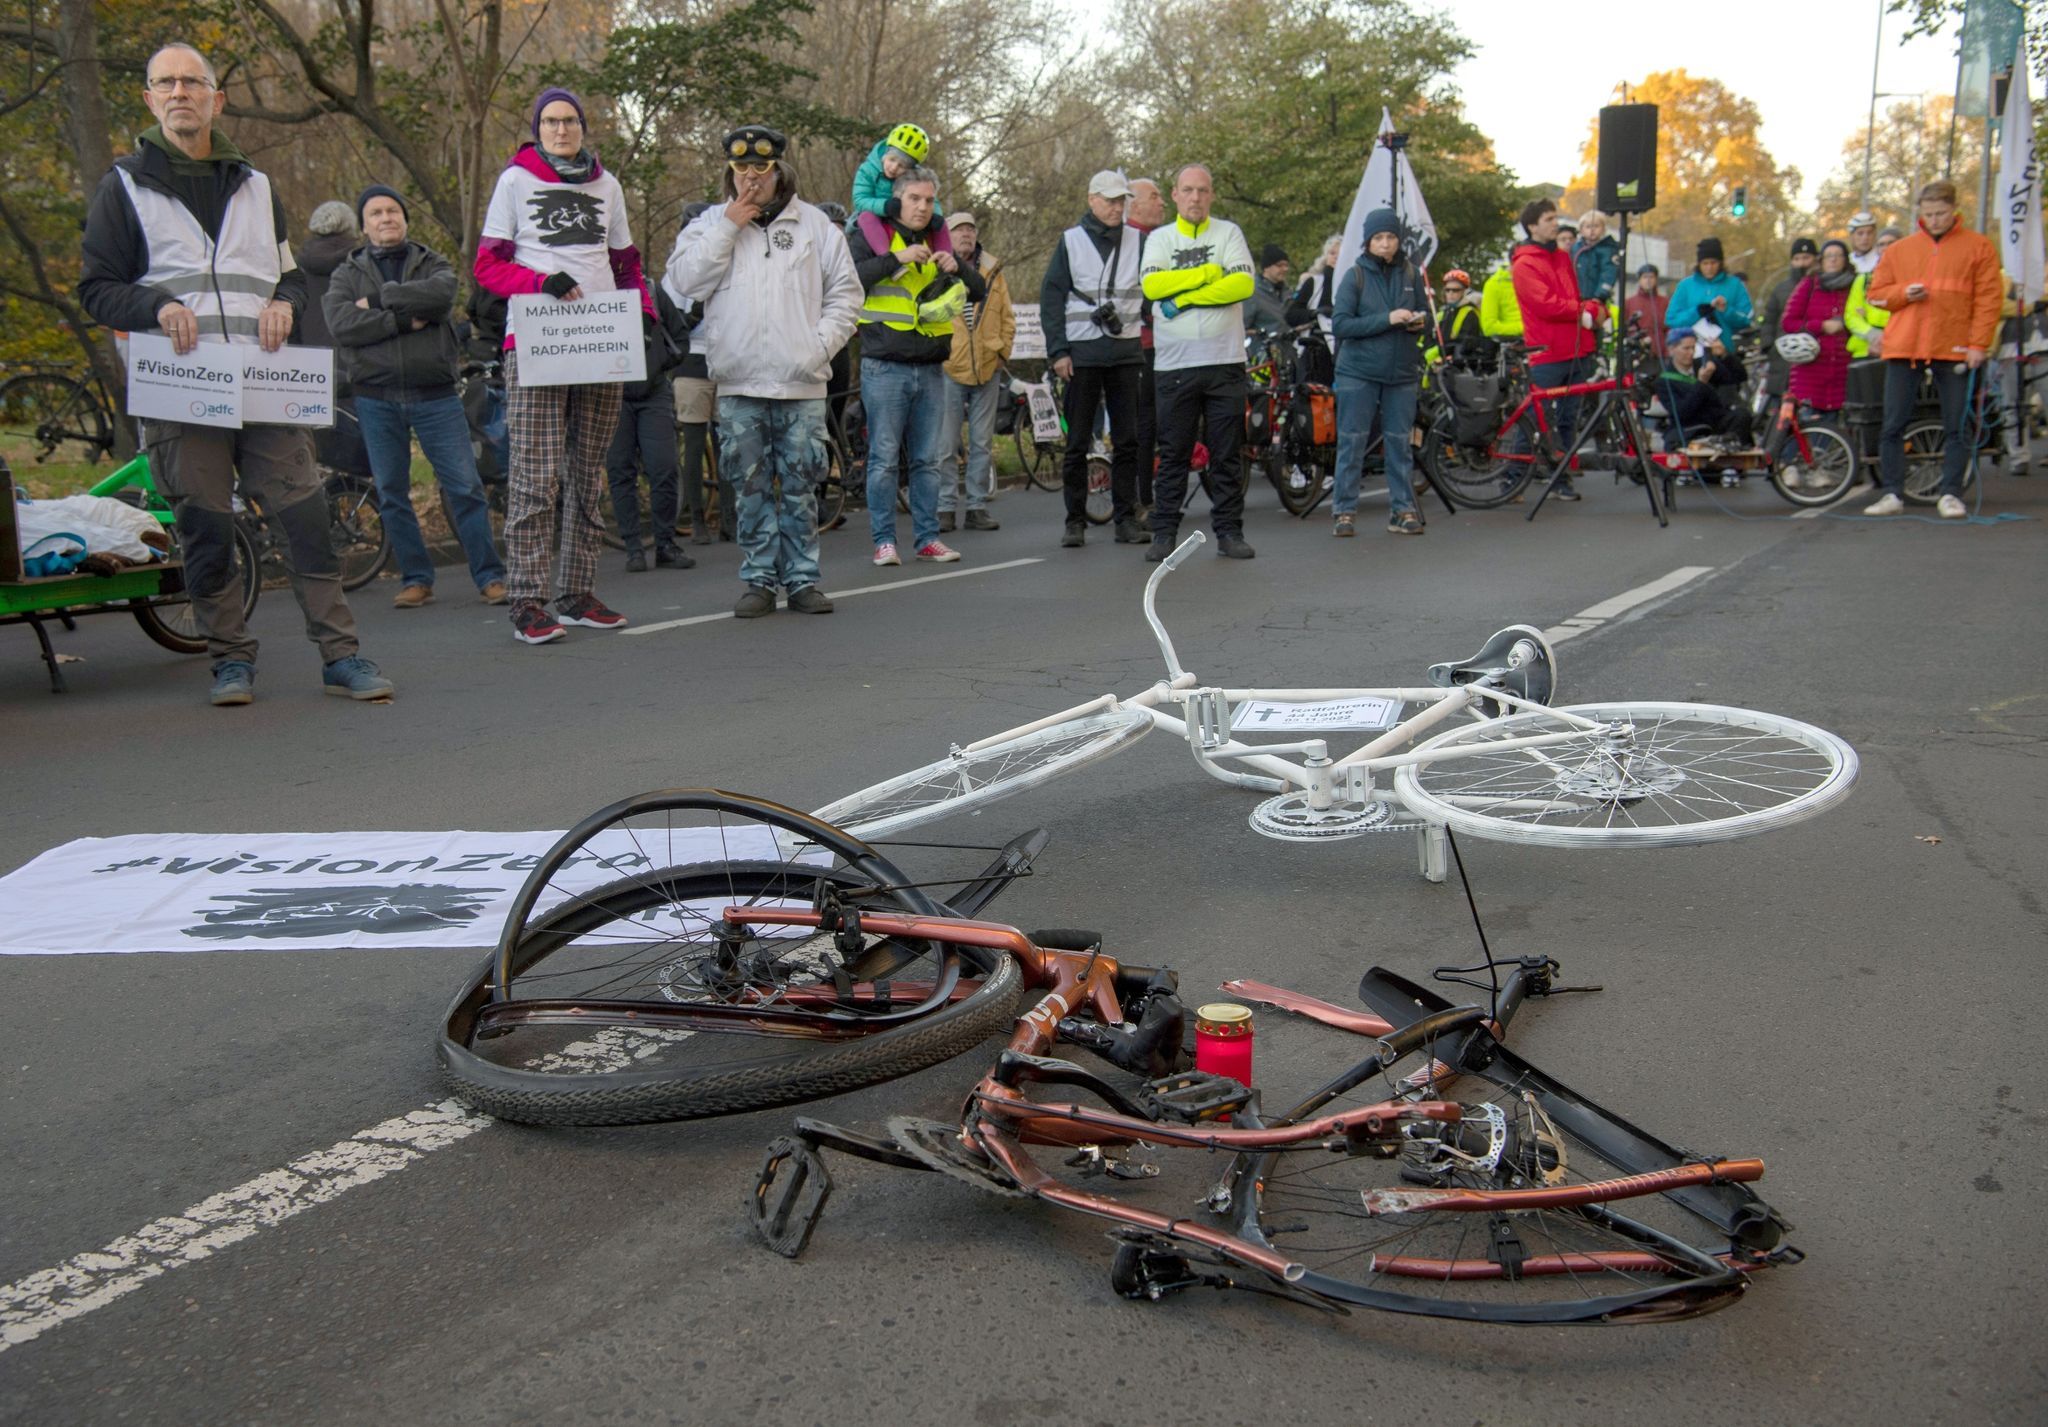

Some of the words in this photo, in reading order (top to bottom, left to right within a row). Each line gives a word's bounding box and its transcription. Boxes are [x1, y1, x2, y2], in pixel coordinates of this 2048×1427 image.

[526, 301, 628, 318] MAHNWACHE
[542, 326, 559, 336] für
[563, 324, 615, 338] getötete
[531, 341, 629, 357] RADFAHRERIN
[137, 358, 234, 384] #VisionZero
[243, 367, 327, 384] VisionZero
[207, 403, 235, 416] adfc
[302, 403, 328, 415] adfc
[1291, 702, 1382, 713] Radfahrerin
[1309, 710, 1354, 718] Jahre
